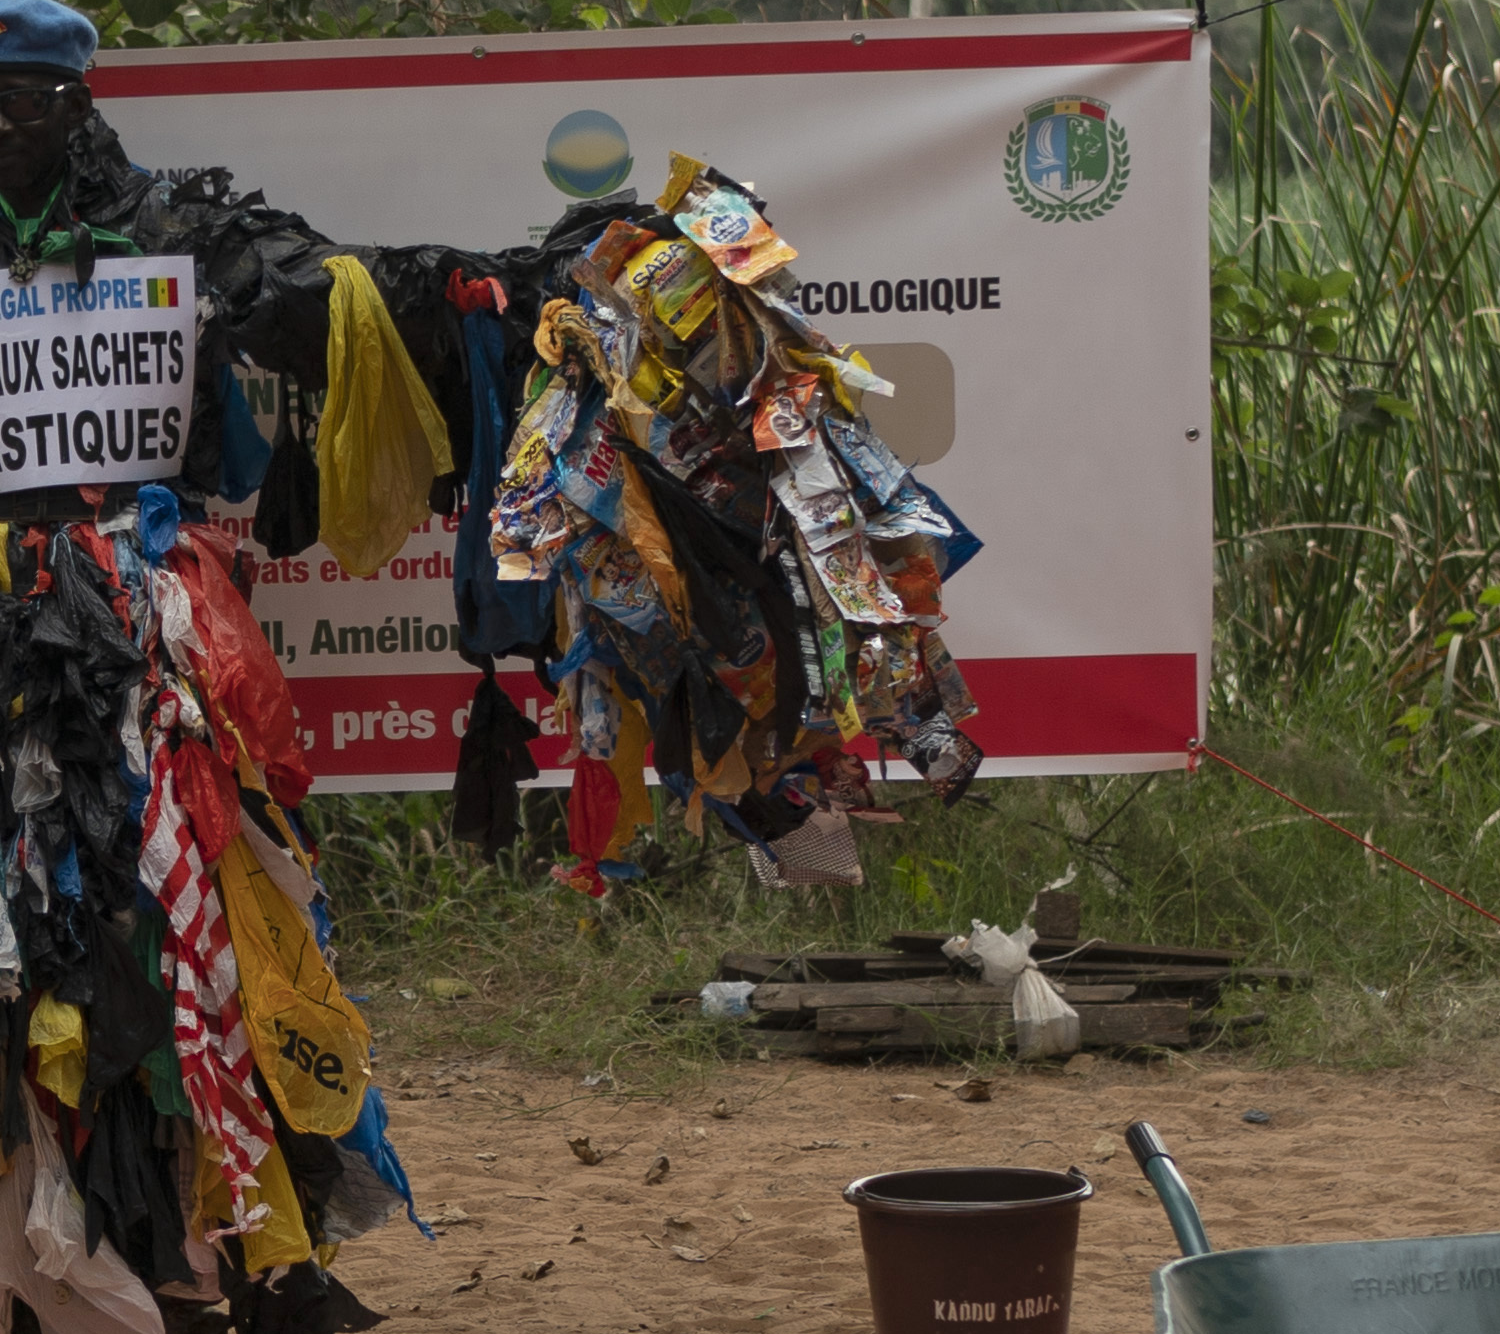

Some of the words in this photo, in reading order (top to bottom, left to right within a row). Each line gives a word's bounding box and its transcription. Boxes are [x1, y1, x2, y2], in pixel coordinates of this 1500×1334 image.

[632, 242, 686, 290] SABA
[51, 277, 143, 314] PROPRE
[51, 330, 184, 390] SACHETS
[332, 701, 436, 750] près
[1351, 1271, 1450, 1301] FRANCE
[933, 1299, 996, 1322] KADDU
